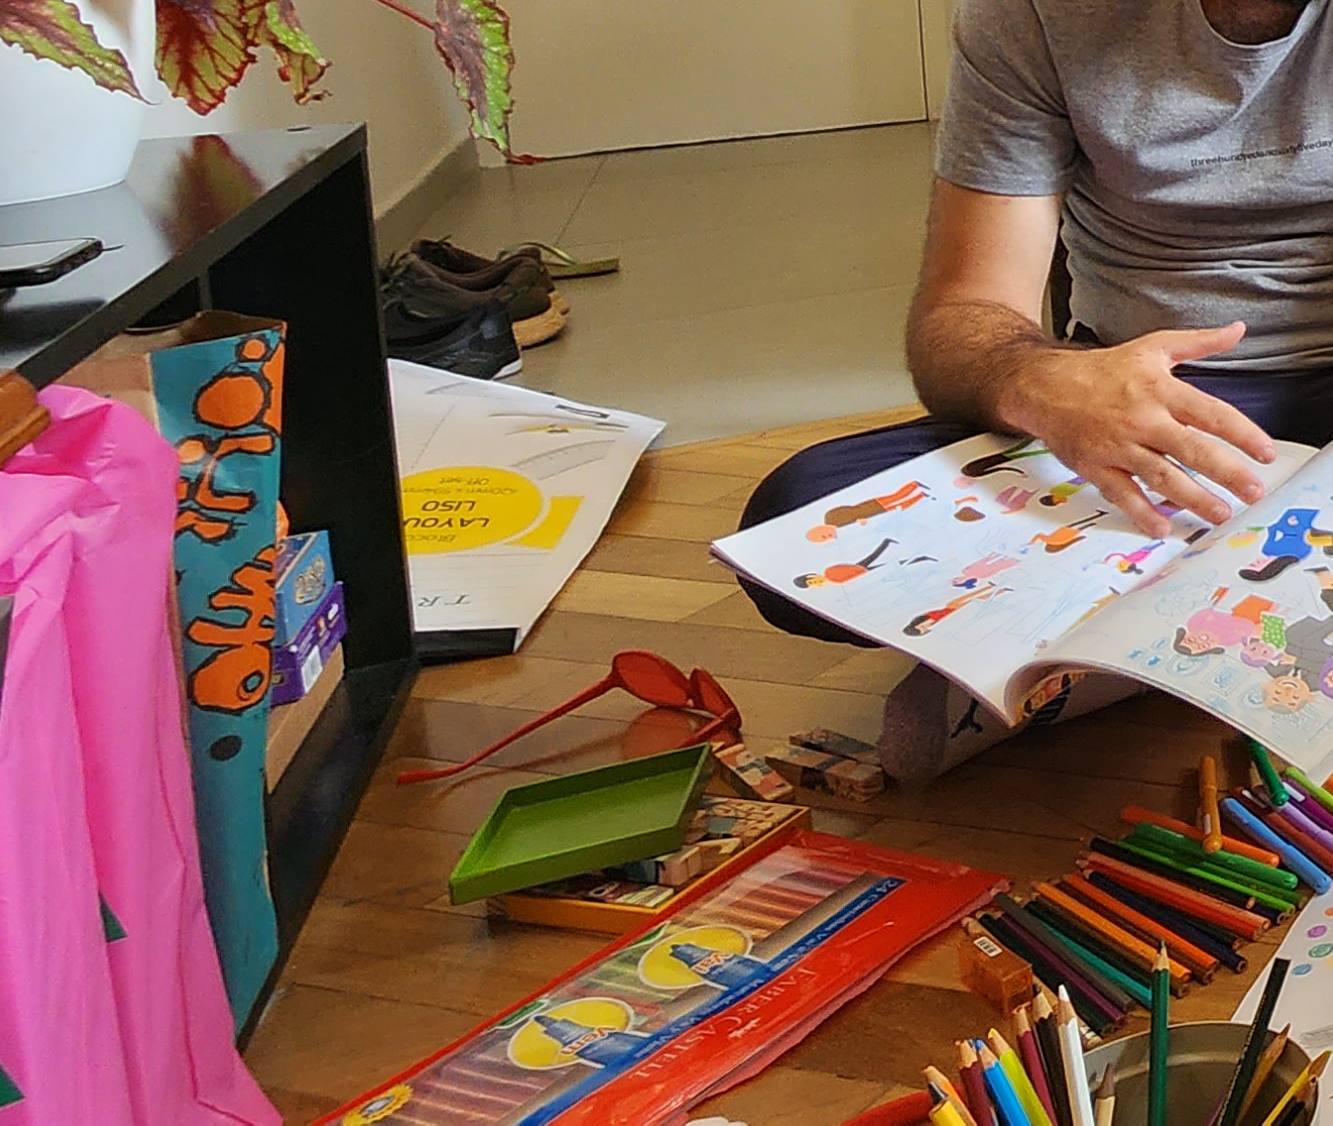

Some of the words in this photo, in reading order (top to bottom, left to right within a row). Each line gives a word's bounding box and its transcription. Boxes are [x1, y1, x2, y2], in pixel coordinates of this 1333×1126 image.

[421, 500, 477, 512] LISO
[875, 876, 897, 895] 24
[689, 951, 734, 974] Vai
[560, 1026, 616, 1056] Vem
